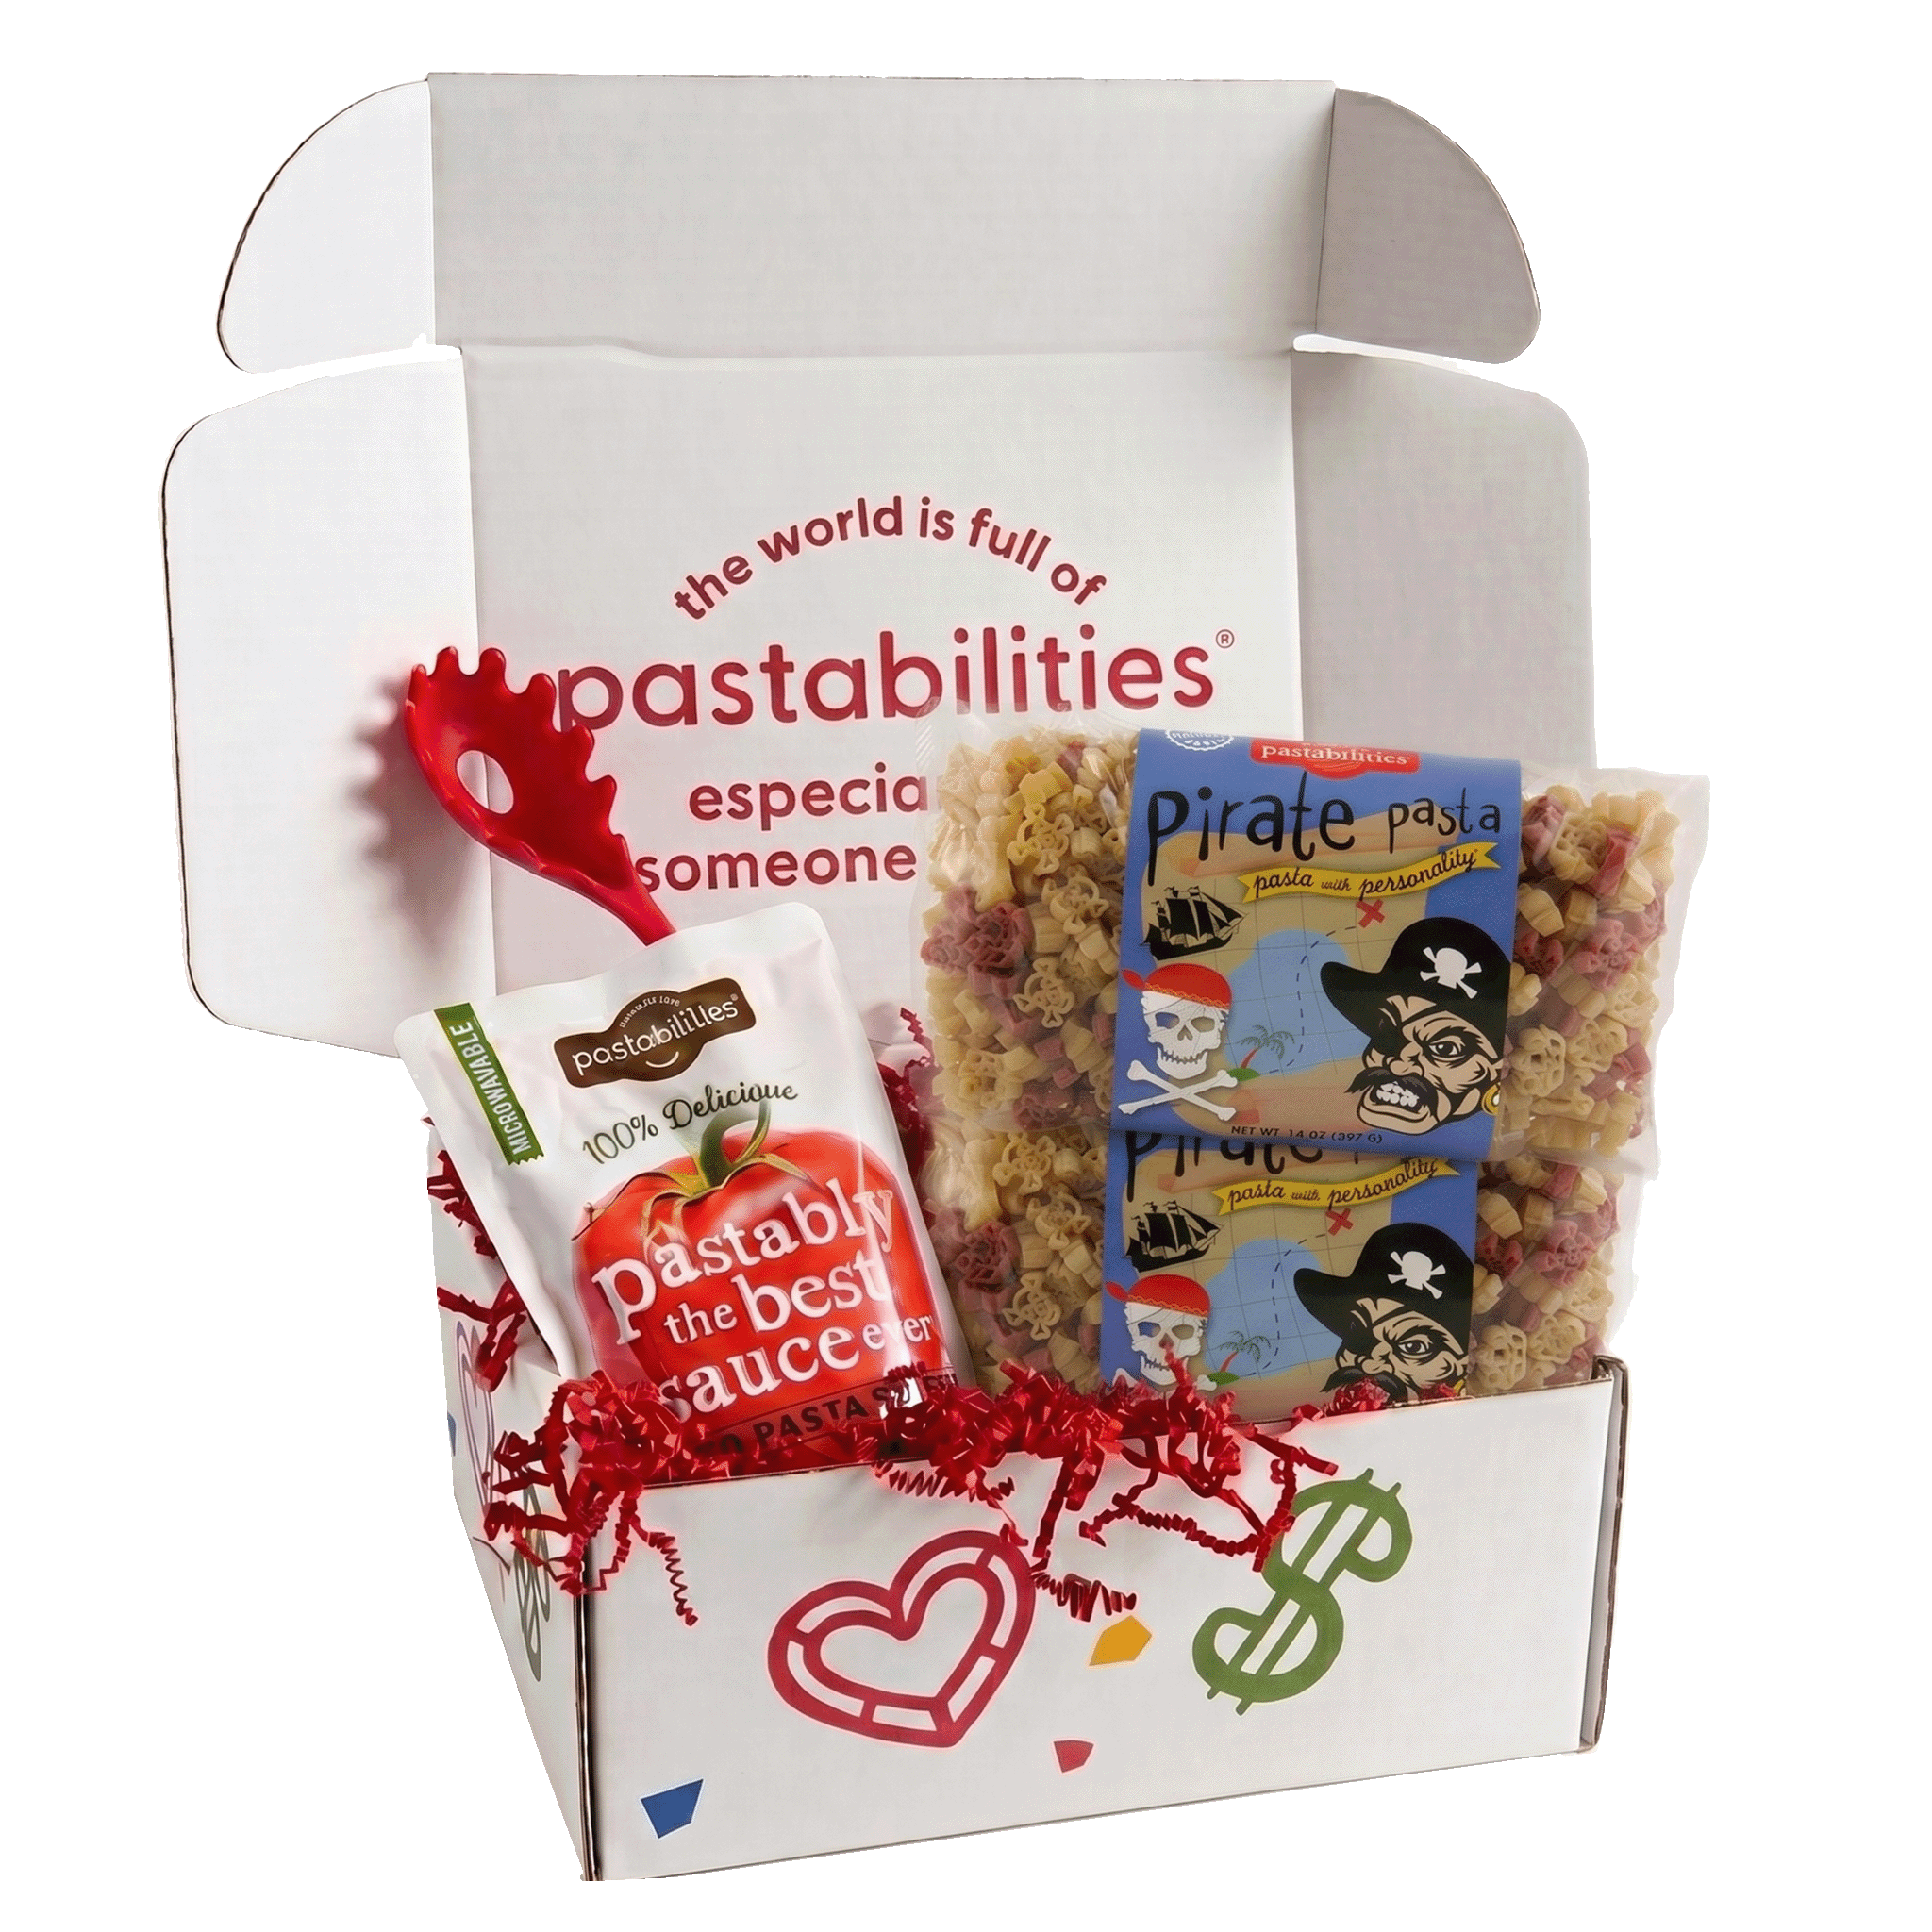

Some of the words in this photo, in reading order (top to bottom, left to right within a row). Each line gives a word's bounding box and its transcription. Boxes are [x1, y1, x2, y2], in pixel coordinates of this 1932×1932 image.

[673, 555, 754, 620] the
[757, 495, 904, 563] world
[919, 496, 955, 541] is
[967, 508, 1053, 573] full
[1050, 562, 1108, 606] of
[689, 761, 941, 831] especia
[1387, 787, 1502, 855] pasta
[637, 843, 919, 893] someone
[1253, 865, 1315, 900] pasta
[1320, 875, 1352, 892] with
[1357, 848, 1477, 902] personality
[449, 1021, 532, 1156] MICROWAVABLE
[582, 1114, 659, 1165] 100%
[1230, 1125, 1257, 1136] NET
[1289, 1128, 1305, 1139] 14
[1308, 1130, 1326, 1140] OZ
[1331, 1131, 1363, 1142] (397
[1227, 1180, 1286, 1211] pasta
[1291, 1187, 1321, 1202] with
[1326, 1158, 1439, 1209] personality
[591, 1176, 895, 1346] pastably
[662, 1299, 740, 1346] the
[730, 1251, 891, 1334] best
[658, 1320, 862, 1424] sauce
[752, 1398, 870, 1448] PASTA
